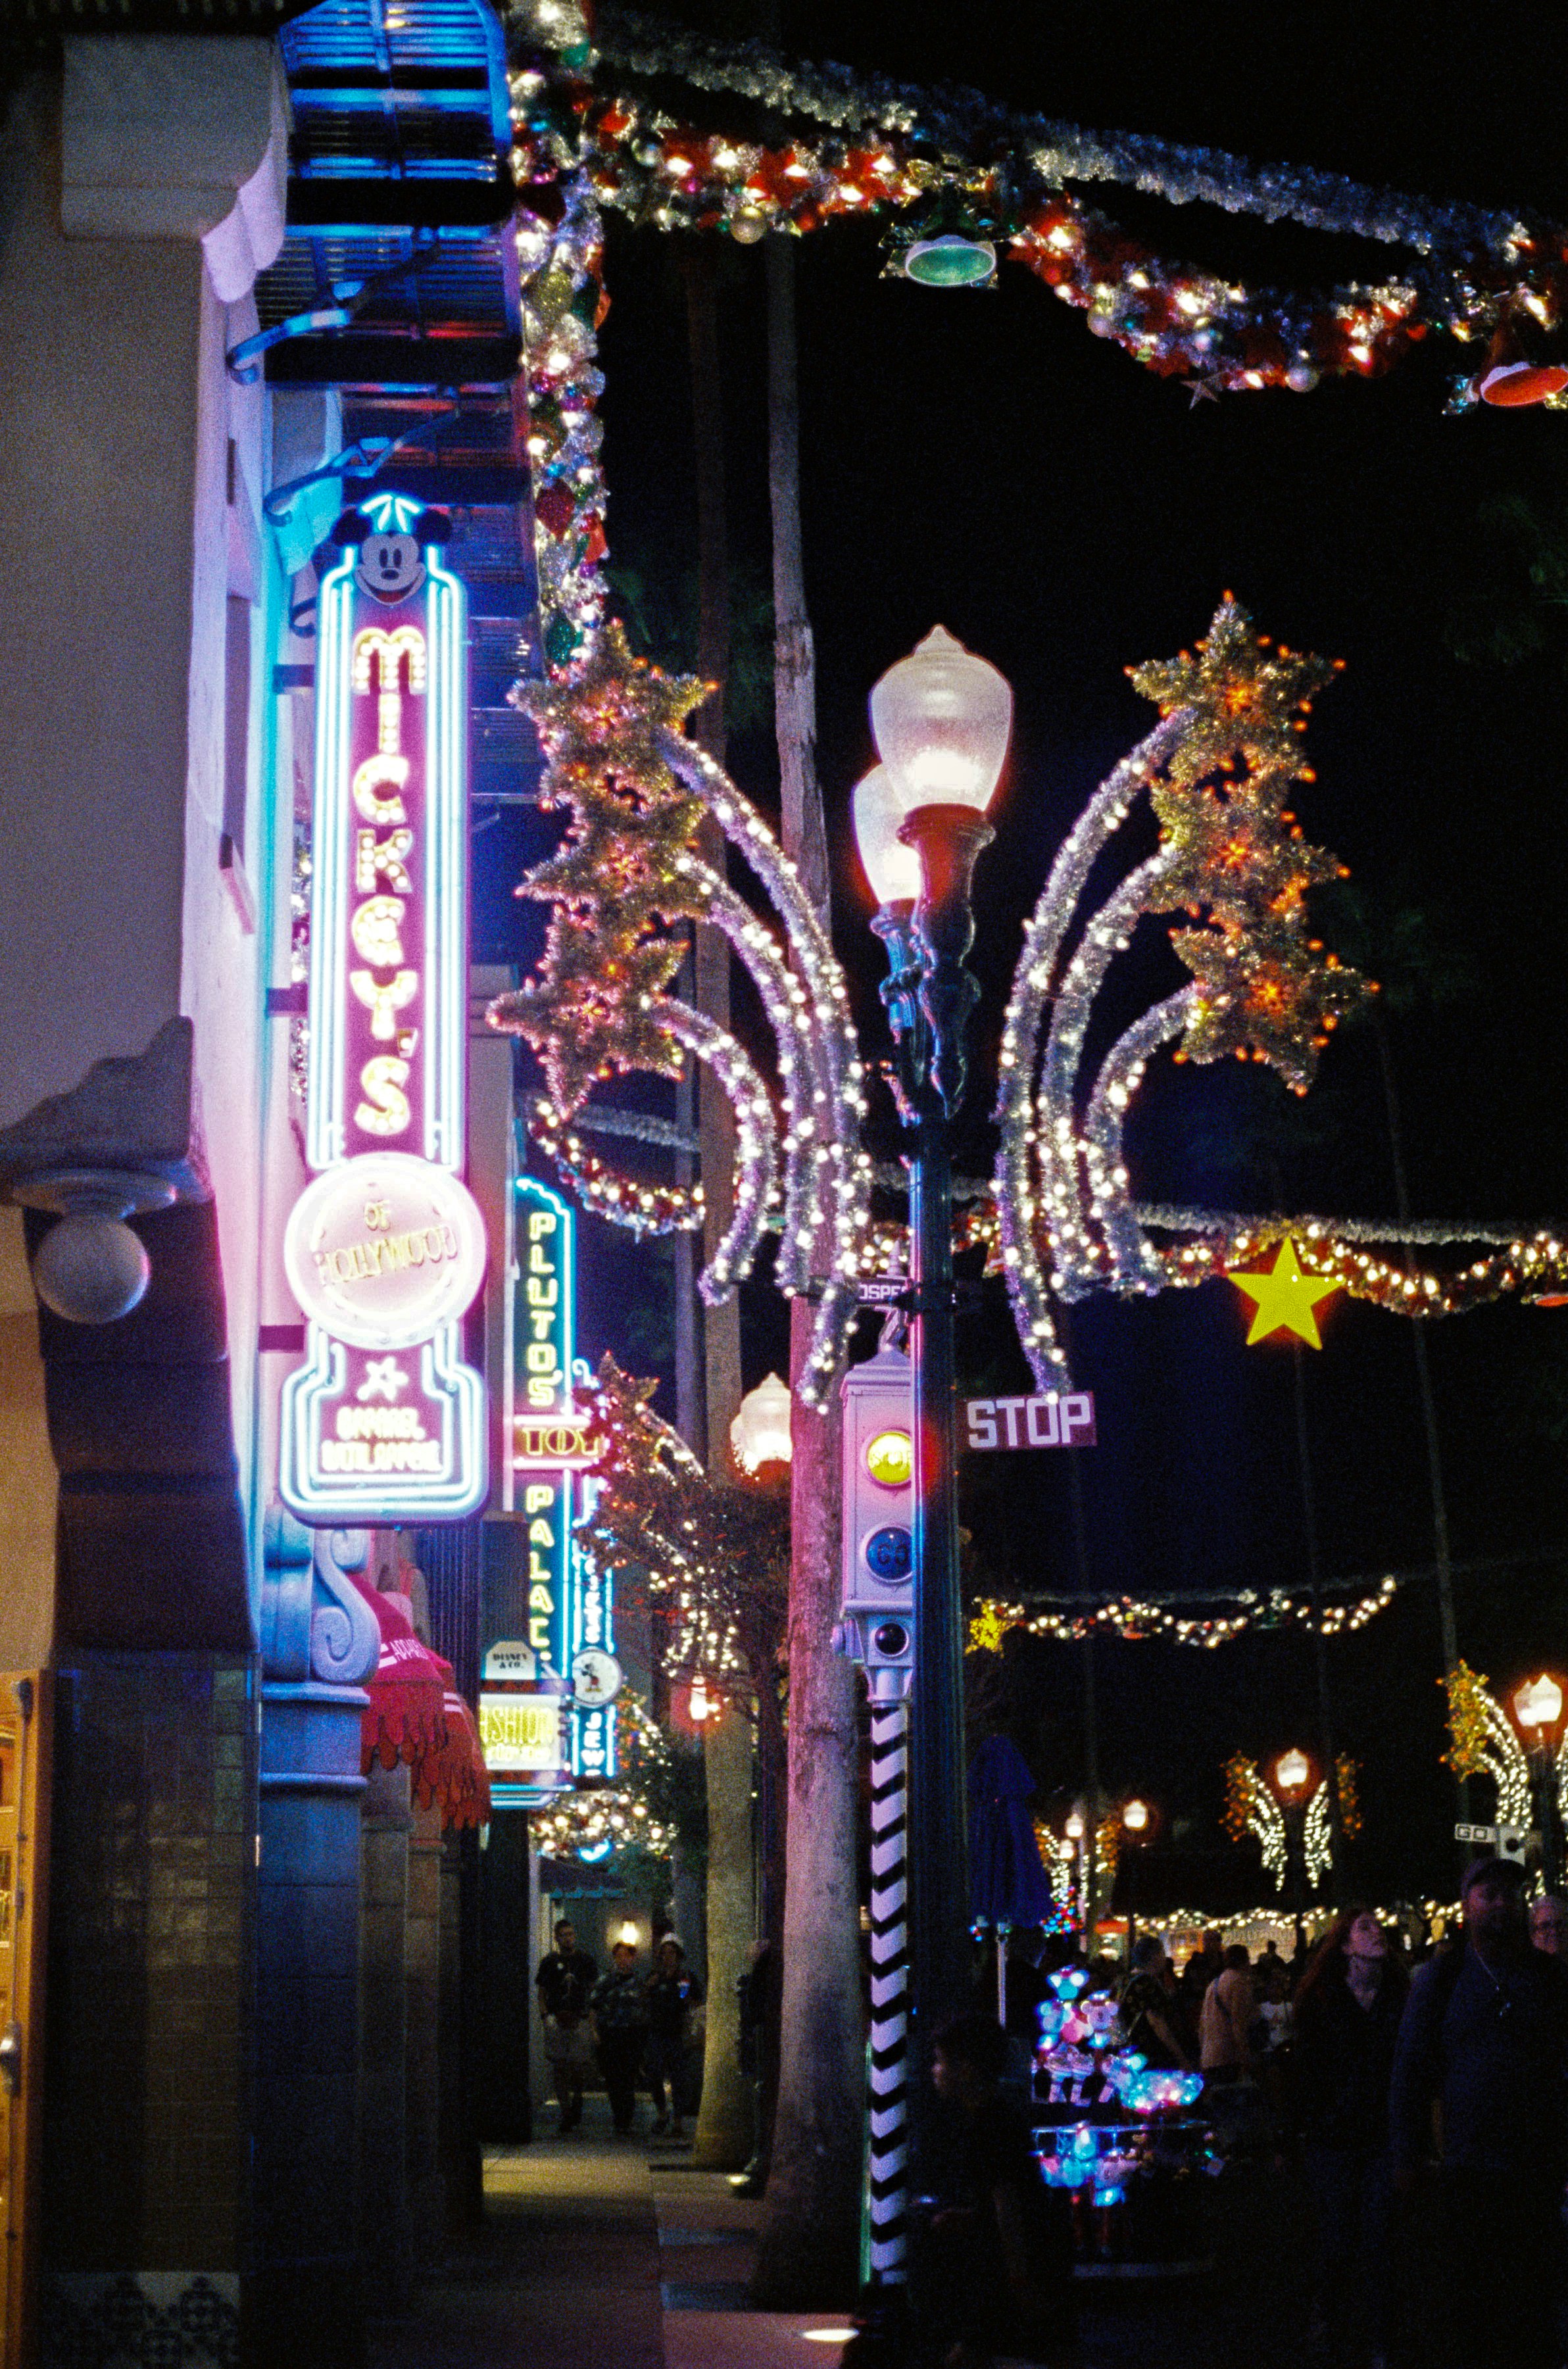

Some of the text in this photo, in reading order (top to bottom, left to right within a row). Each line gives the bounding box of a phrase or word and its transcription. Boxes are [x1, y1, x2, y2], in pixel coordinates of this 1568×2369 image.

[350, 626, 426, 1136] MICKEY'S
[363, 1199, 391, 1231] OF
[317, 1224, 458, 1286] HOLLYWOOD
[527, 1211, 564, 1407] PLUTO'S
[967, 1394, 1092, 1448] STOP
[526, 1486, 554, 1659] PALAC
[493, 1653, 527, 1661] DISNEY
[1456, 1825, 1488, 1840] GO
